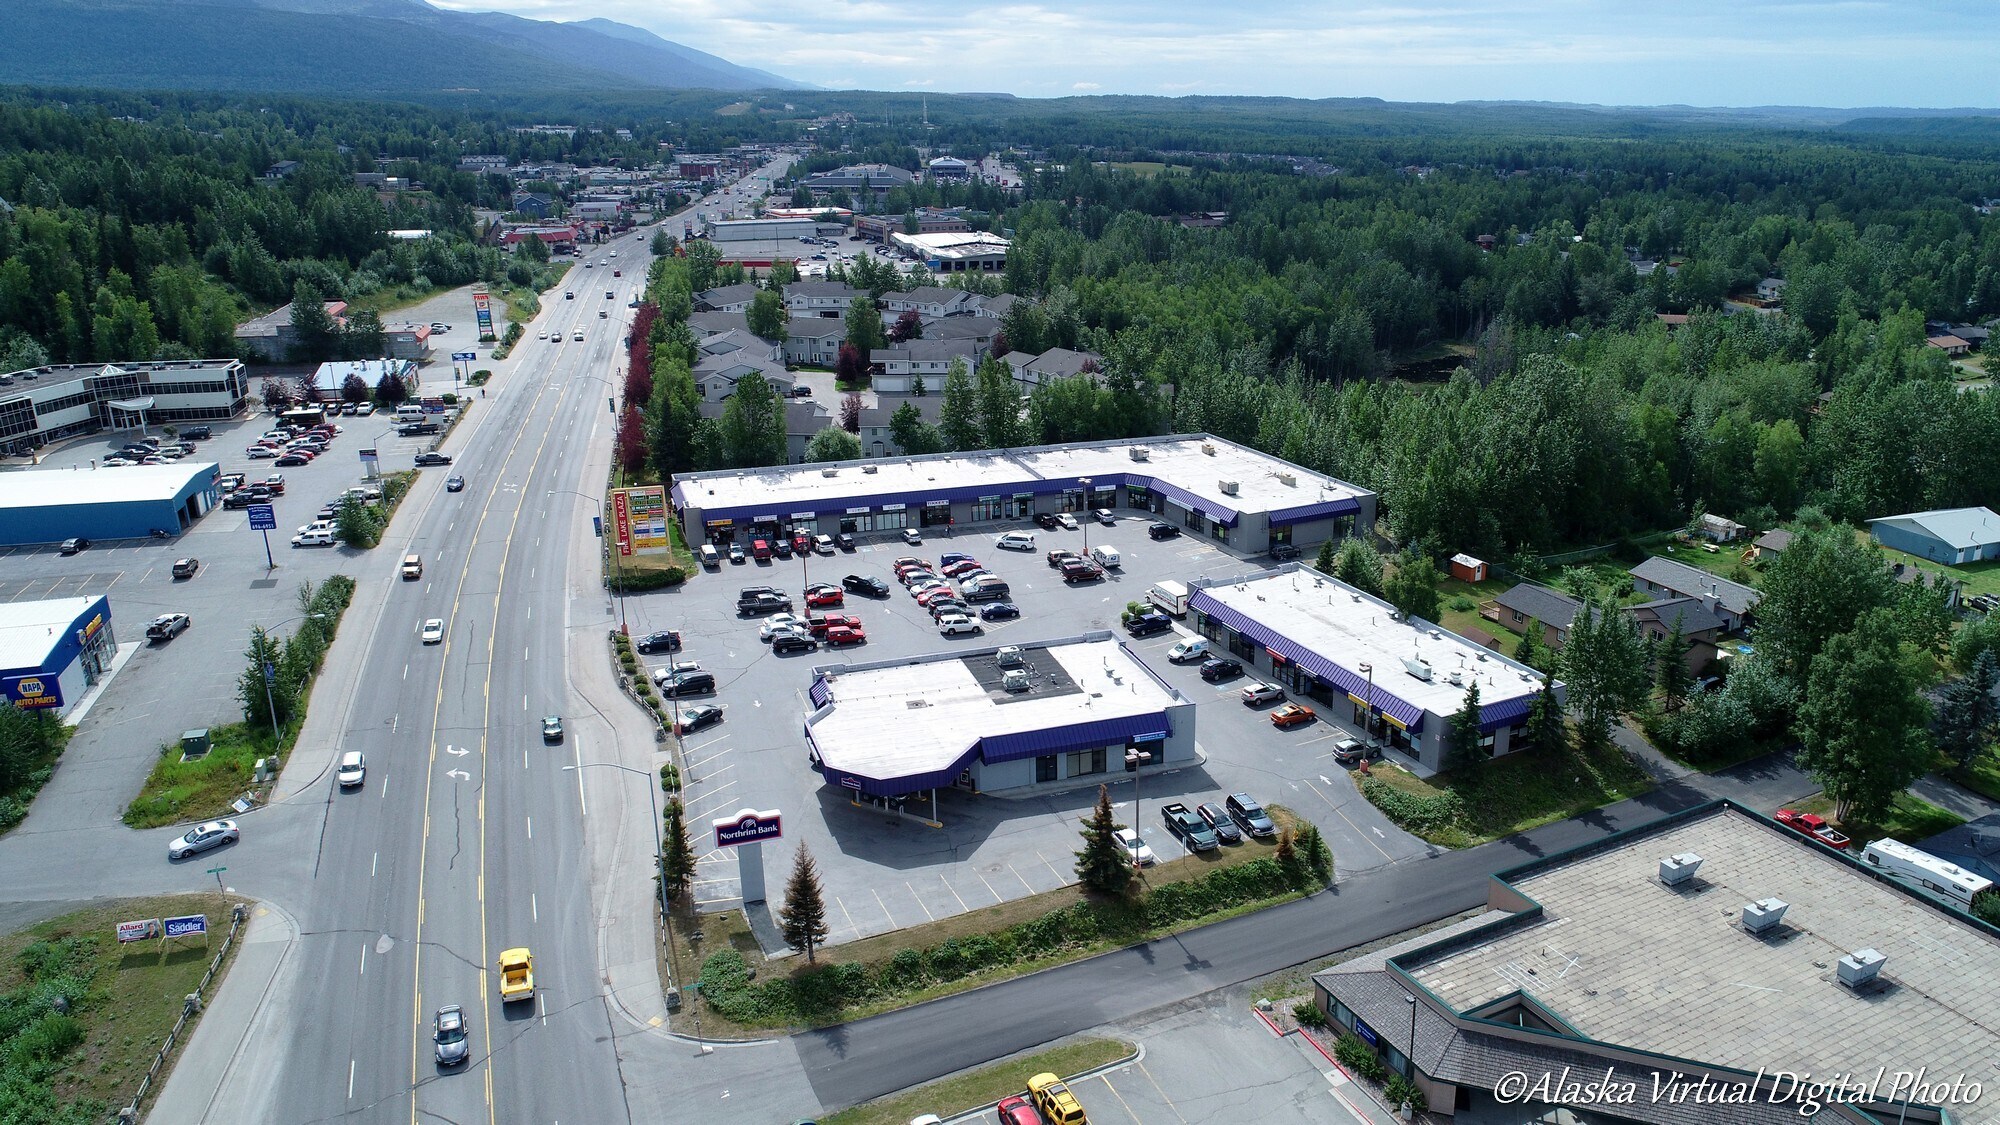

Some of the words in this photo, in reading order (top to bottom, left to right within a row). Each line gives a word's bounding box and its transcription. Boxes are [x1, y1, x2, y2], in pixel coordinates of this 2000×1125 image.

[617, 496, 625, 517] PLAZA
[21, 683, 42, 693] NAPA
[15, 698, 33, 708] AUTO
[34, 696, 57, 705] PARTS
[720, 828, 757, 840] Northrim
[758, 824, 778, 834] Bank
[119, 923, 144, 931] Allard
[168, 922, 202, 933] Saddler
